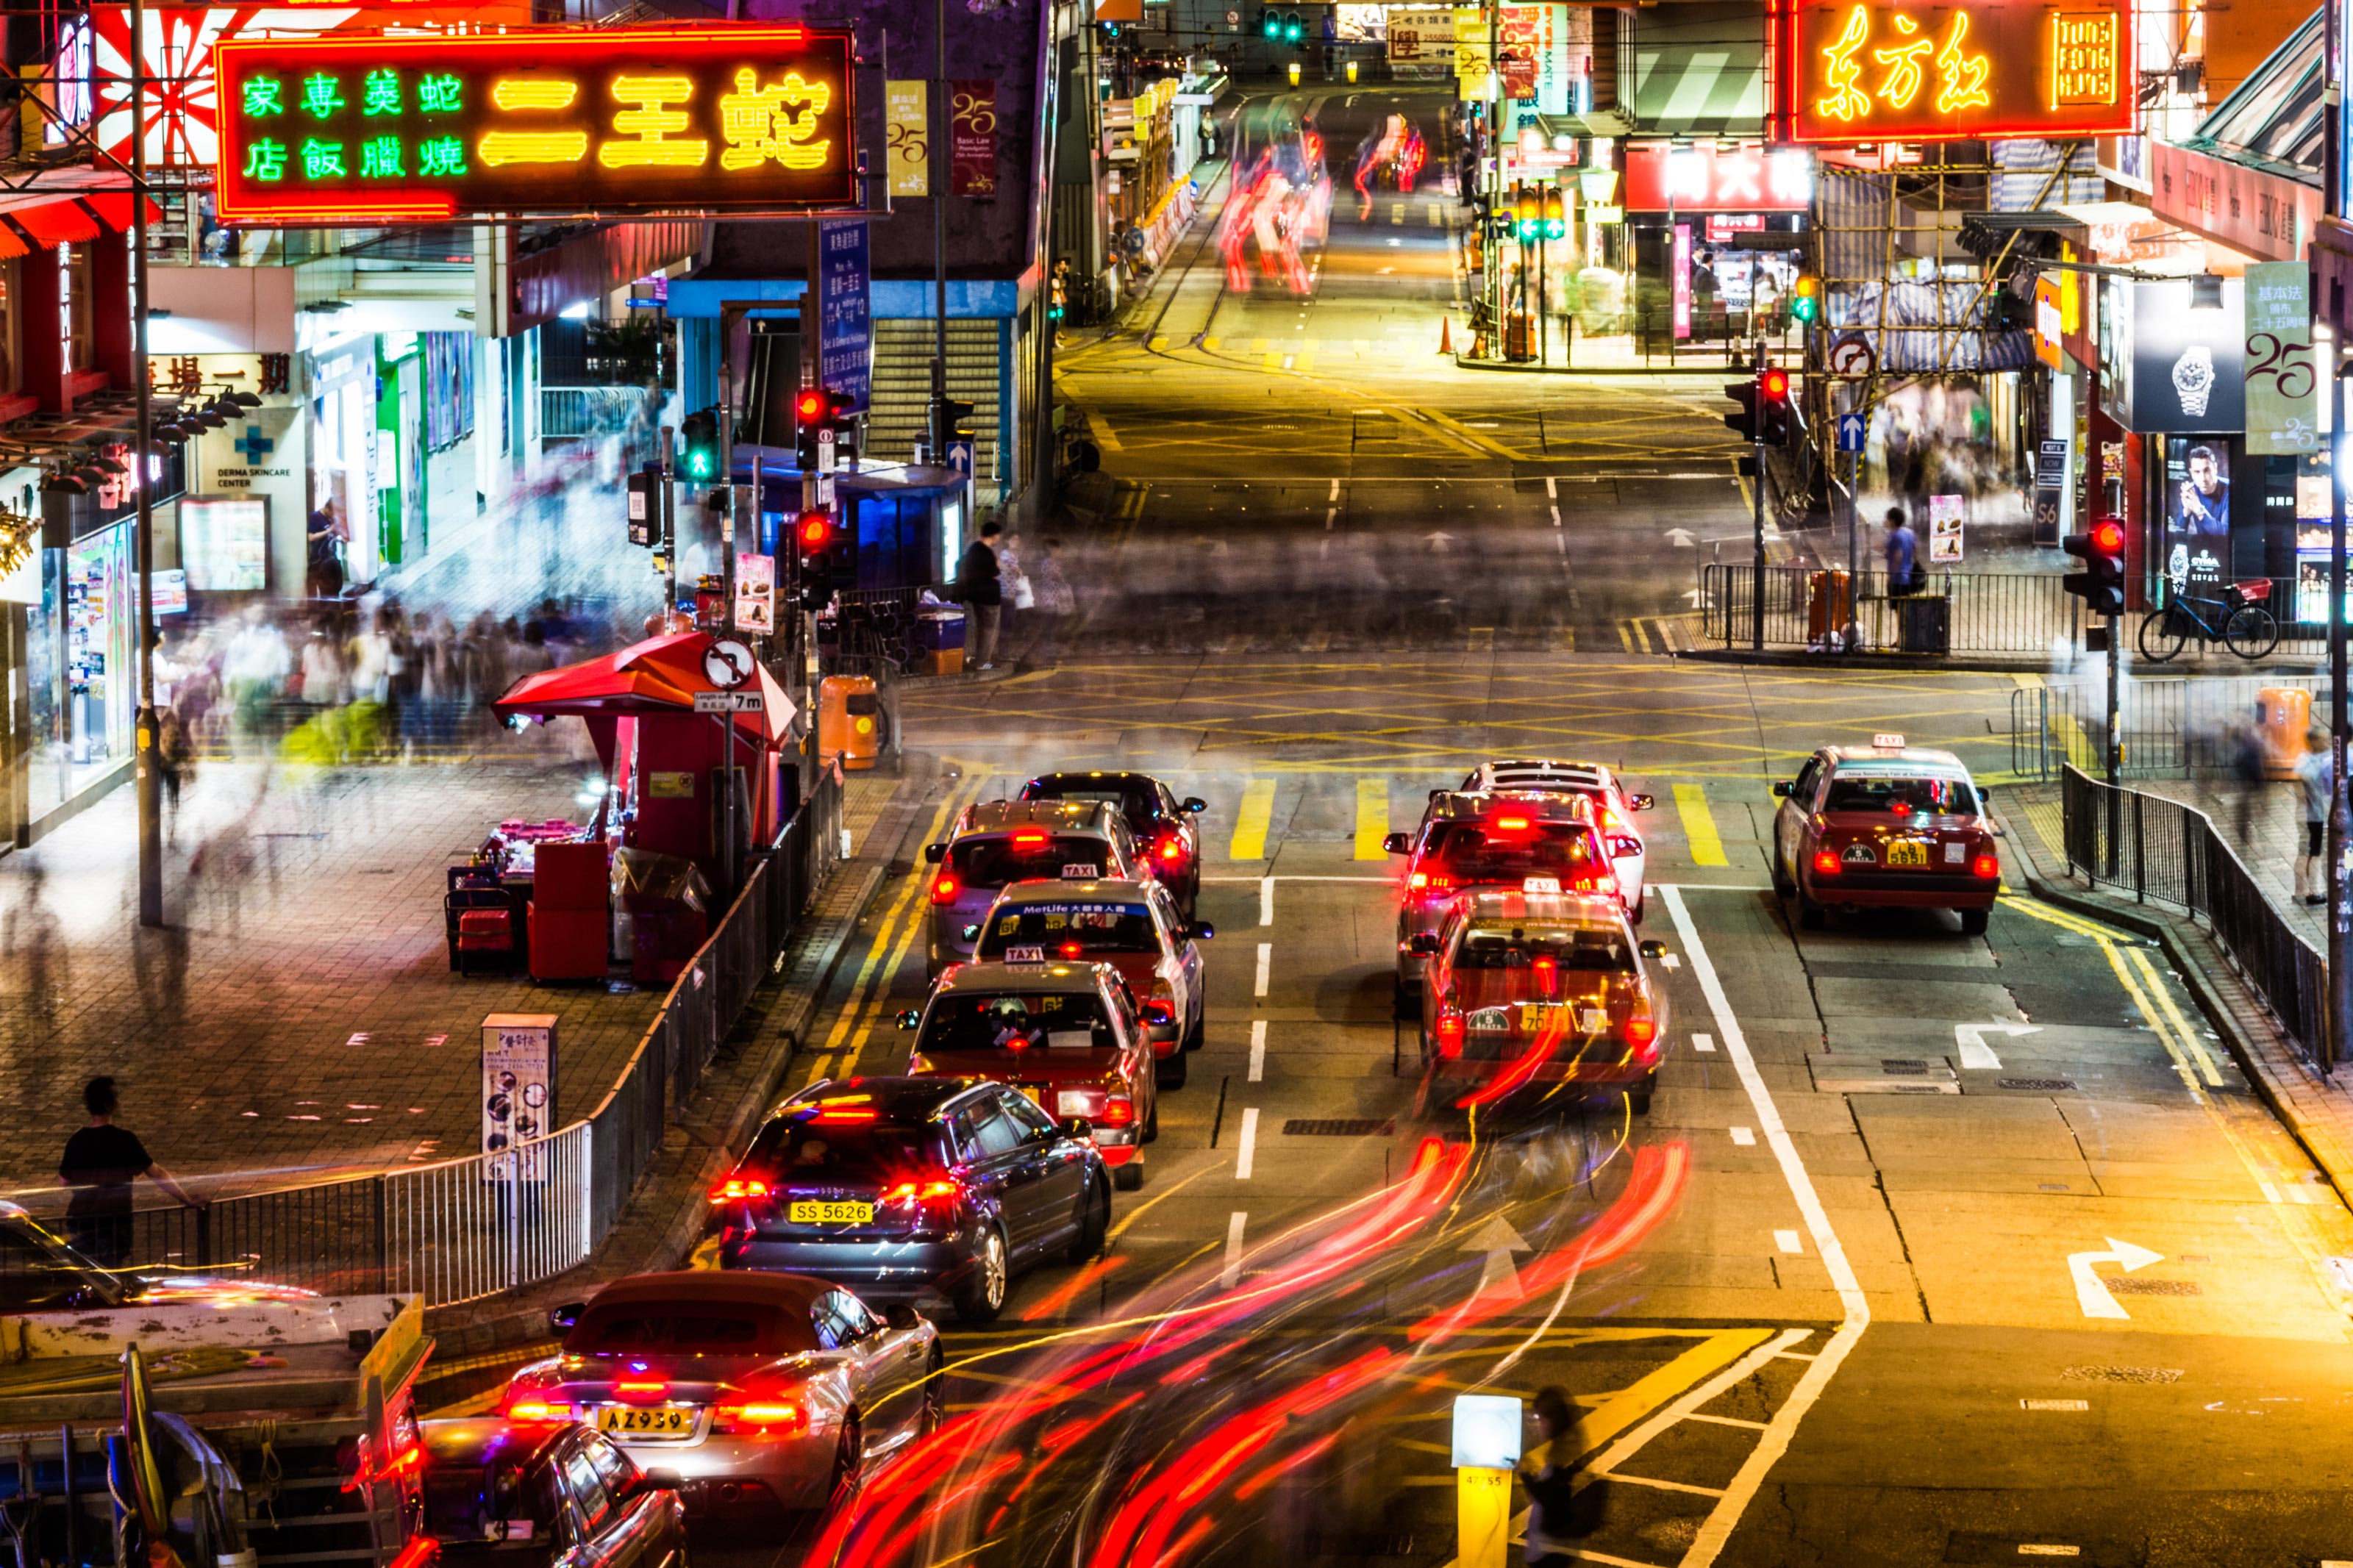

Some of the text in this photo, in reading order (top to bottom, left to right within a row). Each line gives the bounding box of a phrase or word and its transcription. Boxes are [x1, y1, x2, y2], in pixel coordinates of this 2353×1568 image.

[1460, 51, 1488, 78] 25
[953, 93, 996, 134] 25
[888, 123, 926, 162] 25
[2258, 286, 2302, 301] 基本法
[2269, 304, 2291, 315] 頒布
[2252, 316, 2308, 330] 二十五周年
[2245, 333, 2316, 398] 25
[2285, 418, 2314, 447] 25
[2037, 504, 2056, 523] S6
[735, 695, 760, 708] 7 m
[1890, 853, 1924, 863] 5651
[1066, 867, 1093, 876] TAXI
[1529, 881, 1557, 889] TAXI
[1024, 906, 1068, 914] MetLife
[1009, 949, 1040, 959] TAXI
[1485, 1015, 1493, 1023] 5
[797, 1206, 866, 1219] SS 5626
[608, 1412, 681, 1428] AZ939
